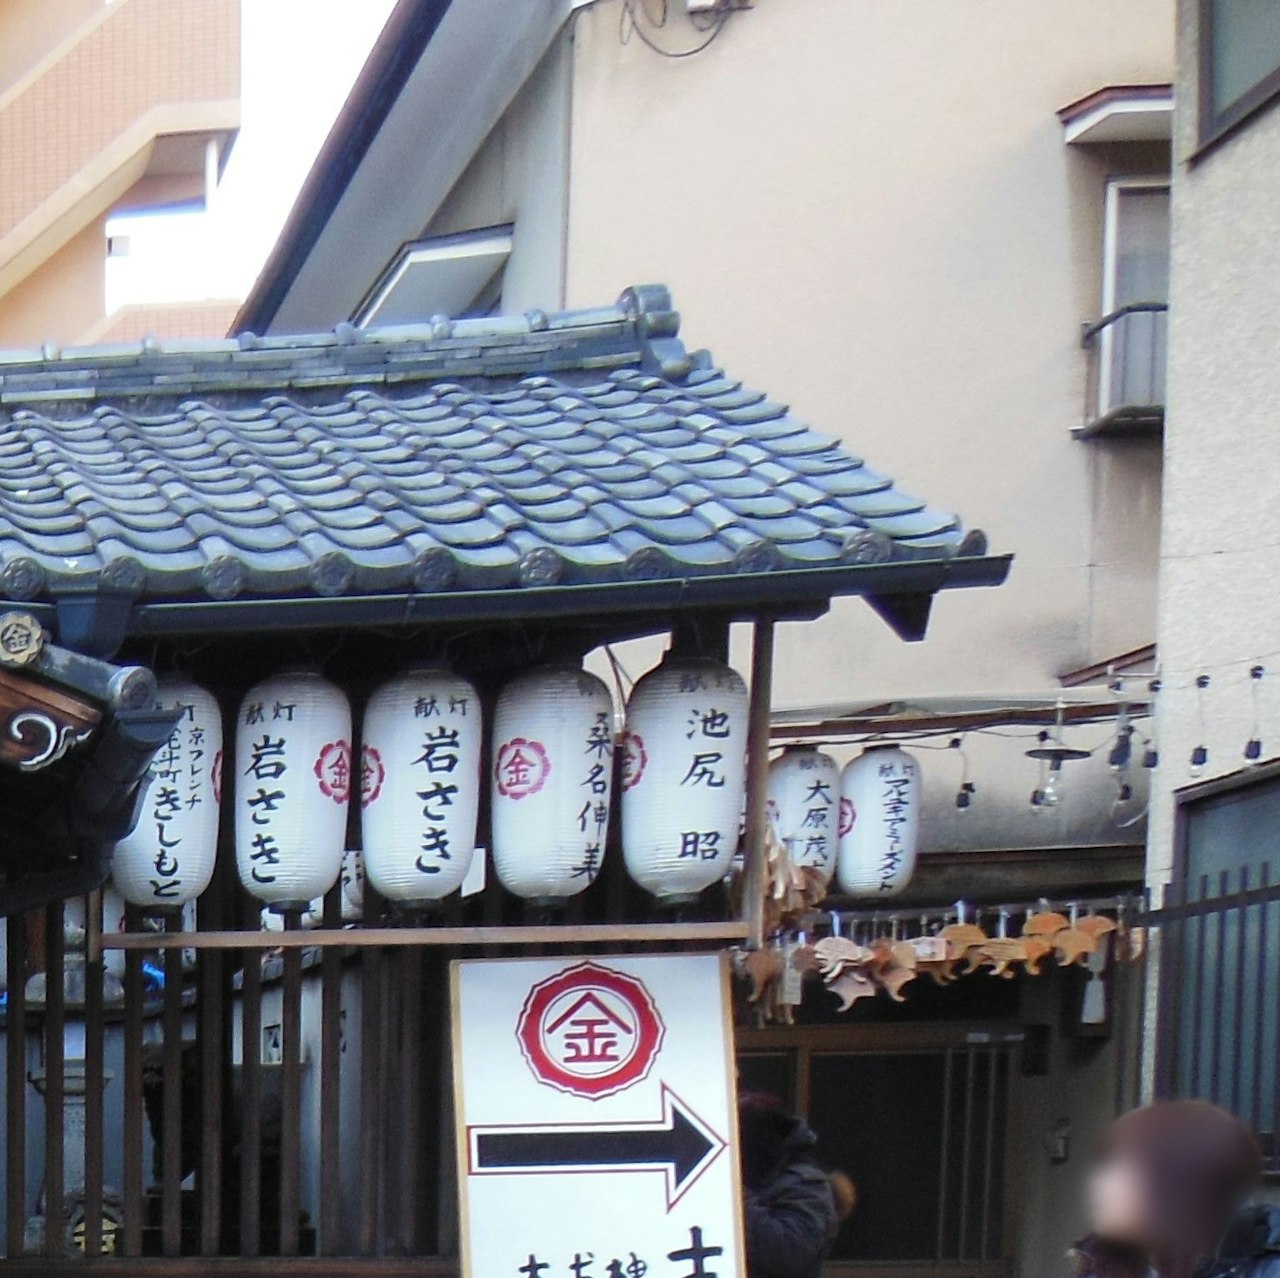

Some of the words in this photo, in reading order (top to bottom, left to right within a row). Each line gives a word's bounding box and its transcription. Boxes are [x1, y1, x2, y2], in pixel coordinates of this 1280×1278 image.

[244, 701, 297, 726] 献灯
[681, 708, 730, 788] 池尻
[185, 727, 205, 811] 京フレンチ
[410, 725, 460, 876] 岩さき
[503, 748, 536, 786] 金
[149, 786, 182, 898] きしもと
[243, 733, 288, 884] 岩さき
[677, 830, 720, 861] 昭
[801, 779, 833, 867] 大原茂
[546, 991, 633, 1064] 金
